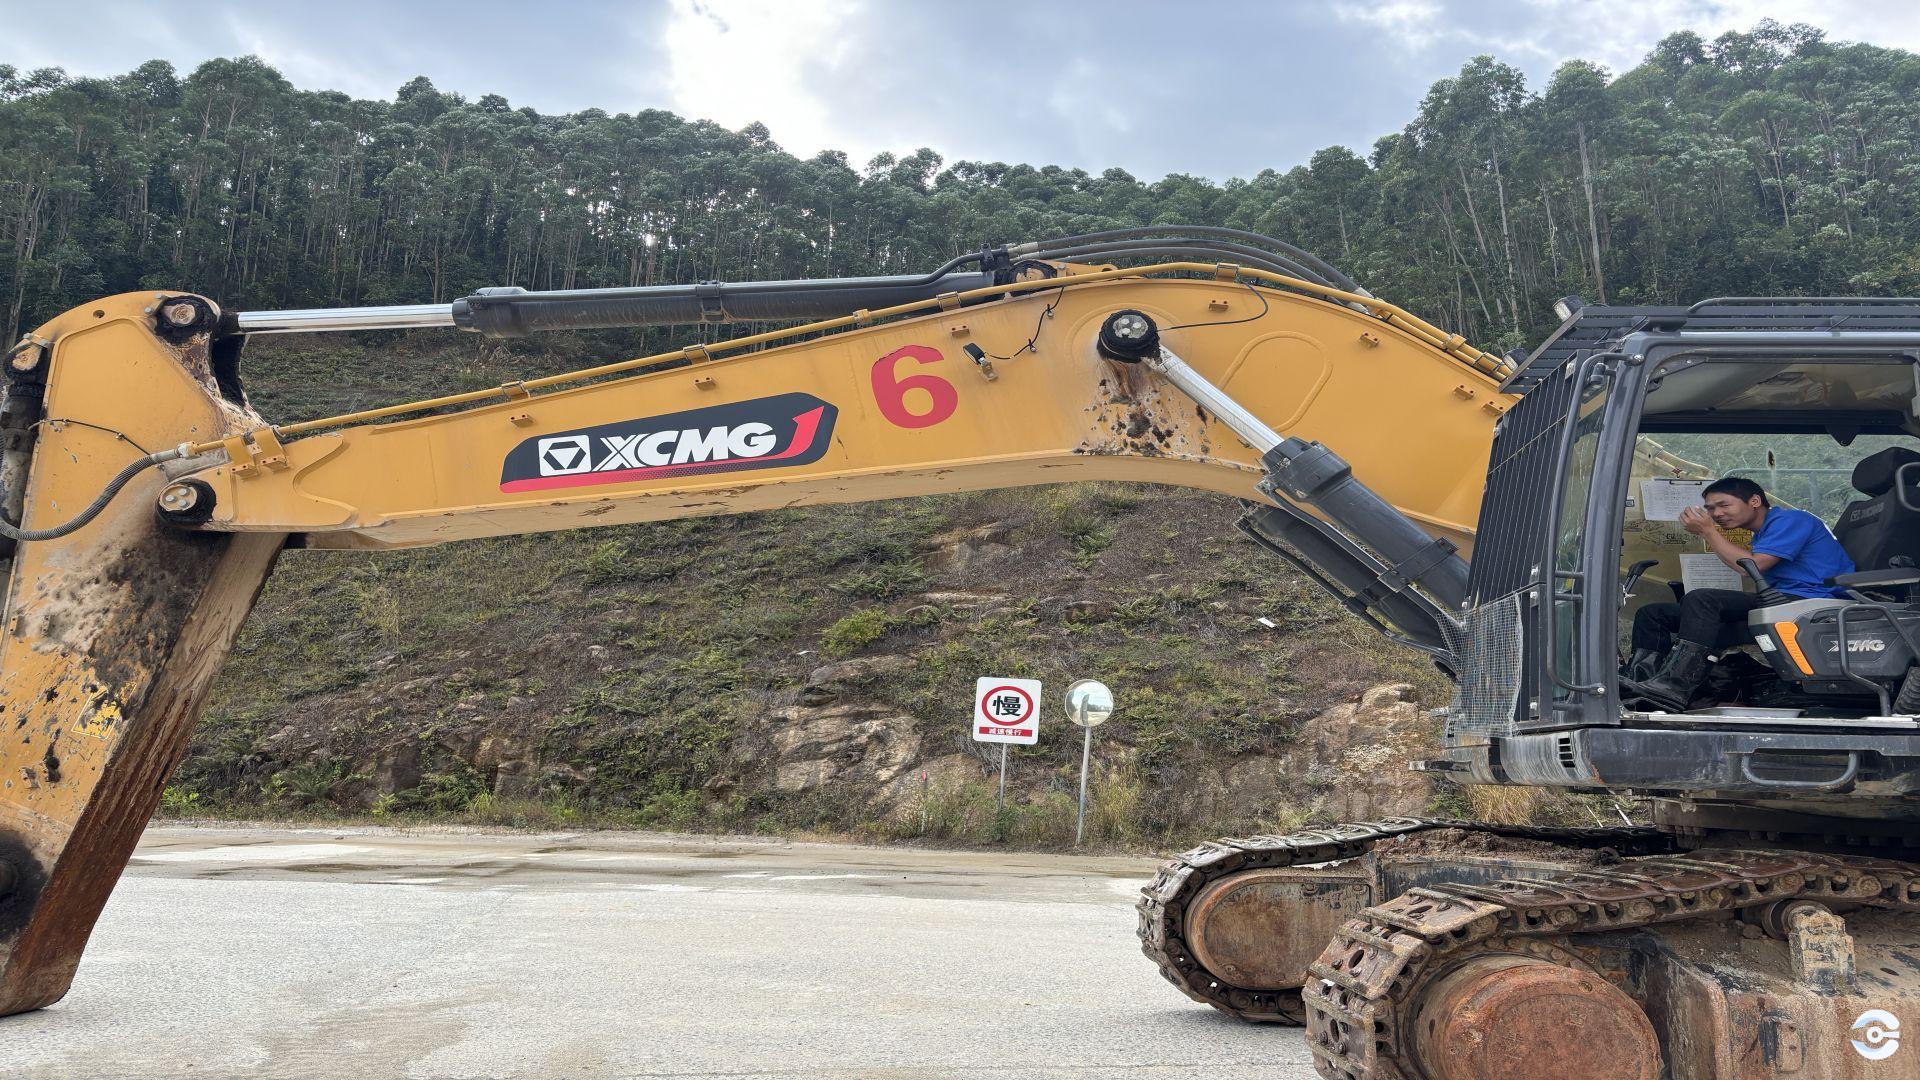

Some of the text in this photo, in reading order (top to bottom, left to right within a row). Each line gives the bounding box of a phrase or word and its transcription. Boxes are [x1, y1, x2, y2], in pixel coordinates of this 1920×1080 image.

[870, 345, 958, 429] 6
[592, 422, 777, 472] XCMG
[993, 695, 1021, 716] 慢
